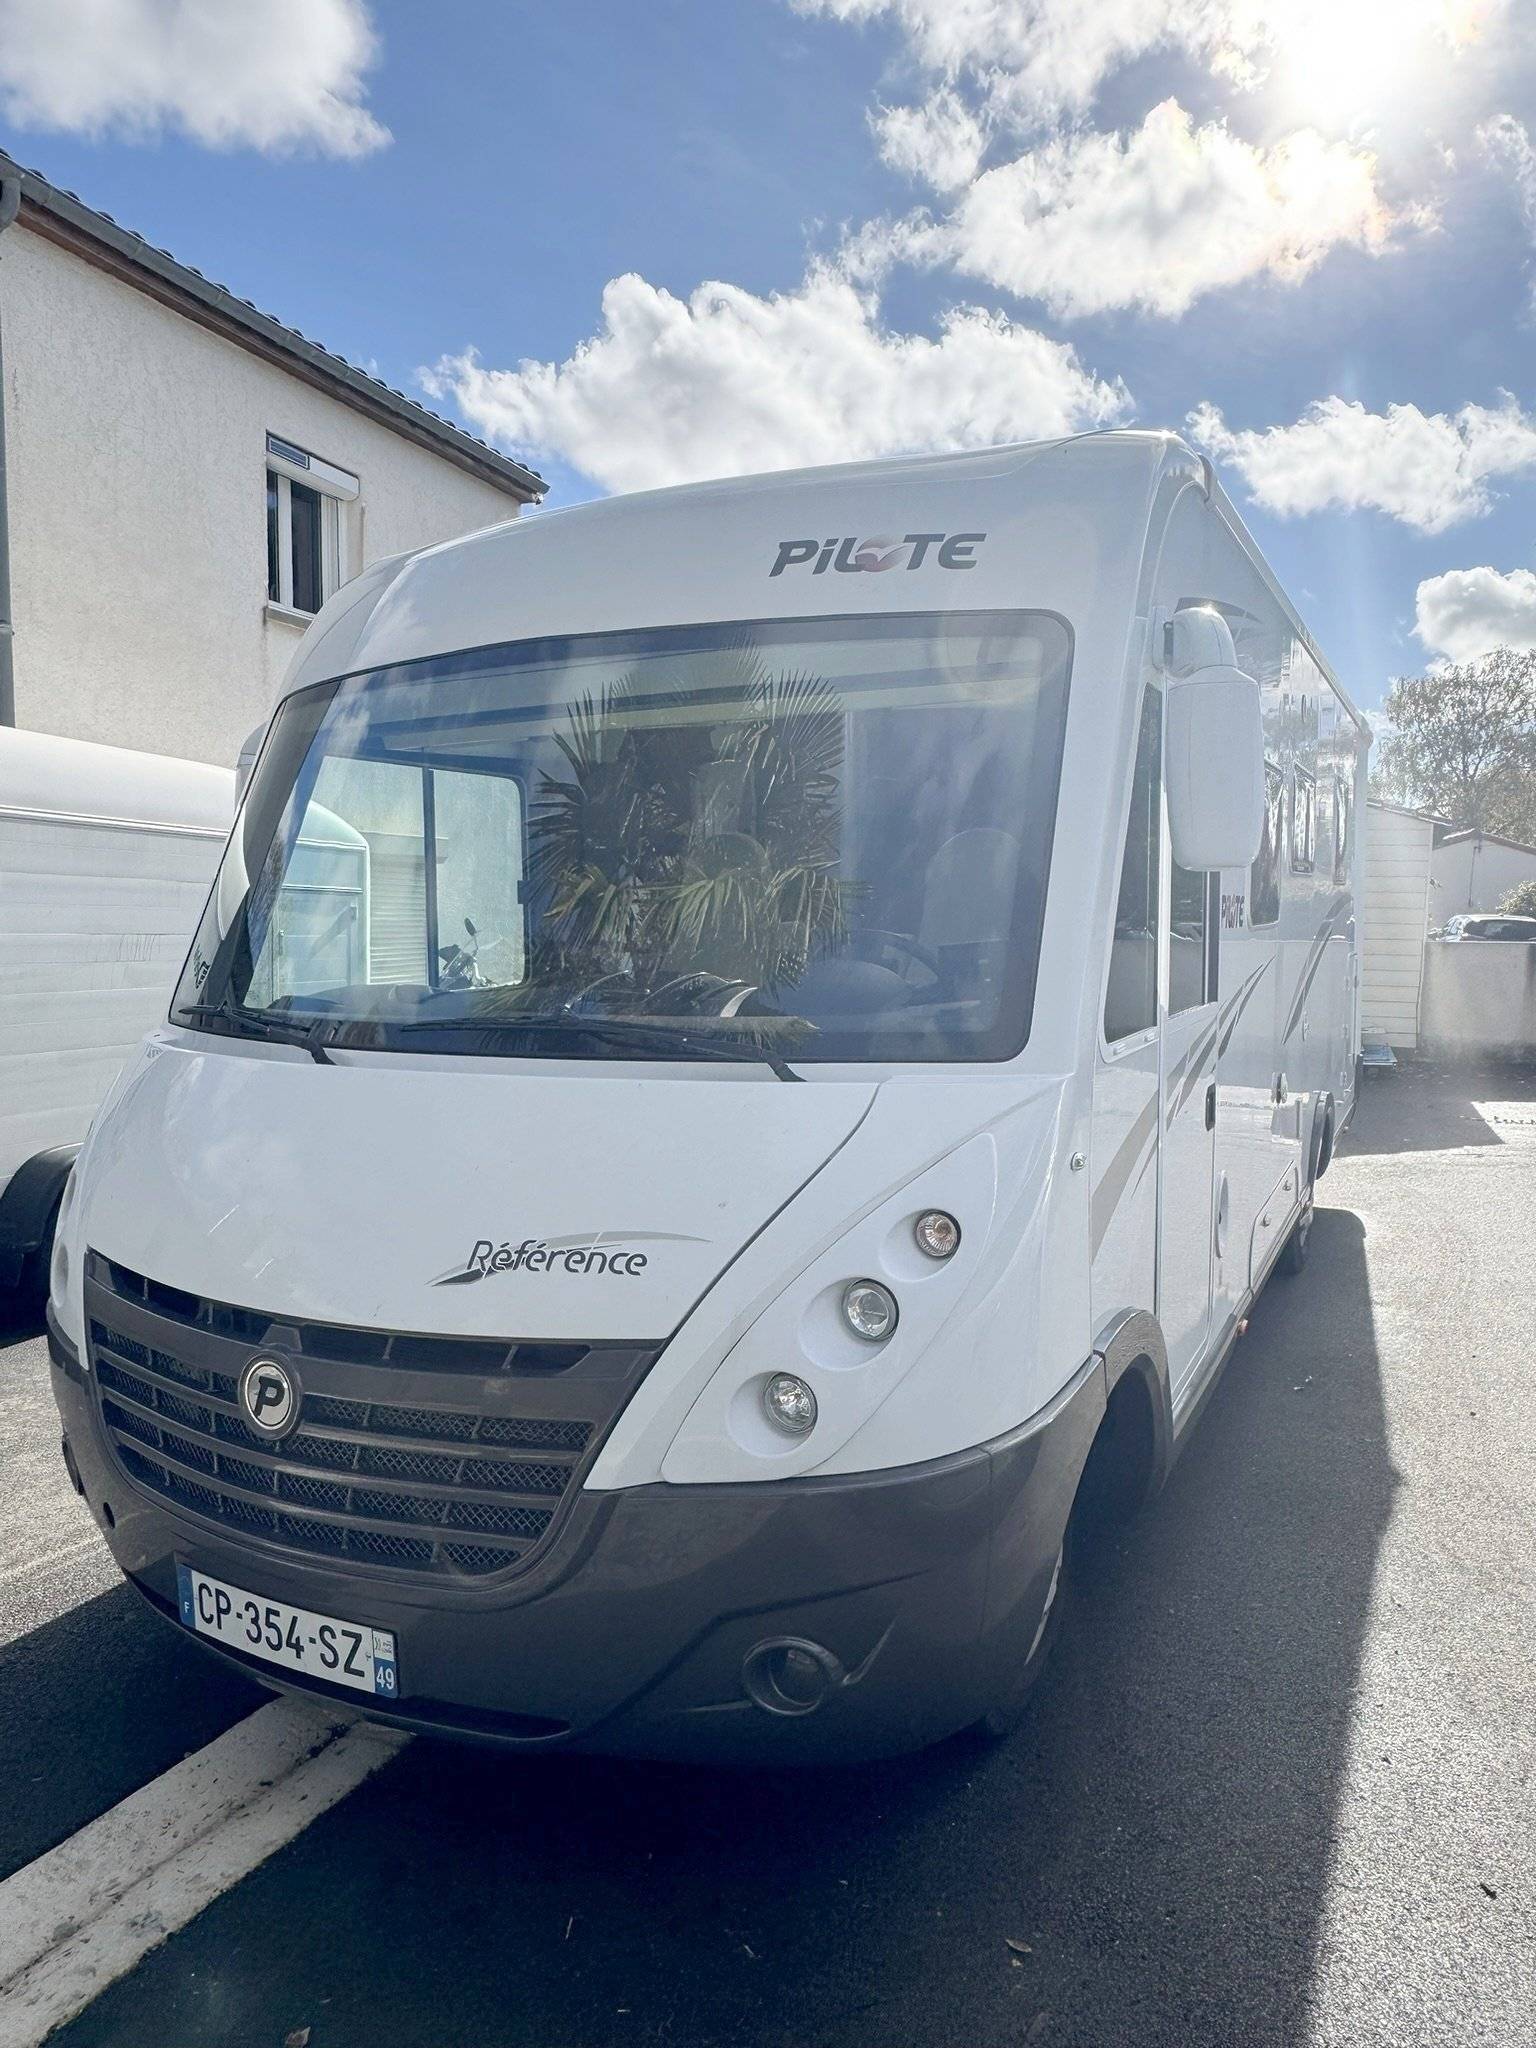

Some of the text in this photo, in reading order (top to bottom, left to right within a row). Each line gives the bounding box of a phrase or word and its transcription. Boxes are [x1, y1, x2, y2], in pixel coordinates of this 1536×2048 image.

[466, 1239, 648, 1276] Référence
[253, 1375, 286, 1419] P
[198, 1582, 366, 1678] CP-354-SZ
[376, 1666, 395, 1691] 49
